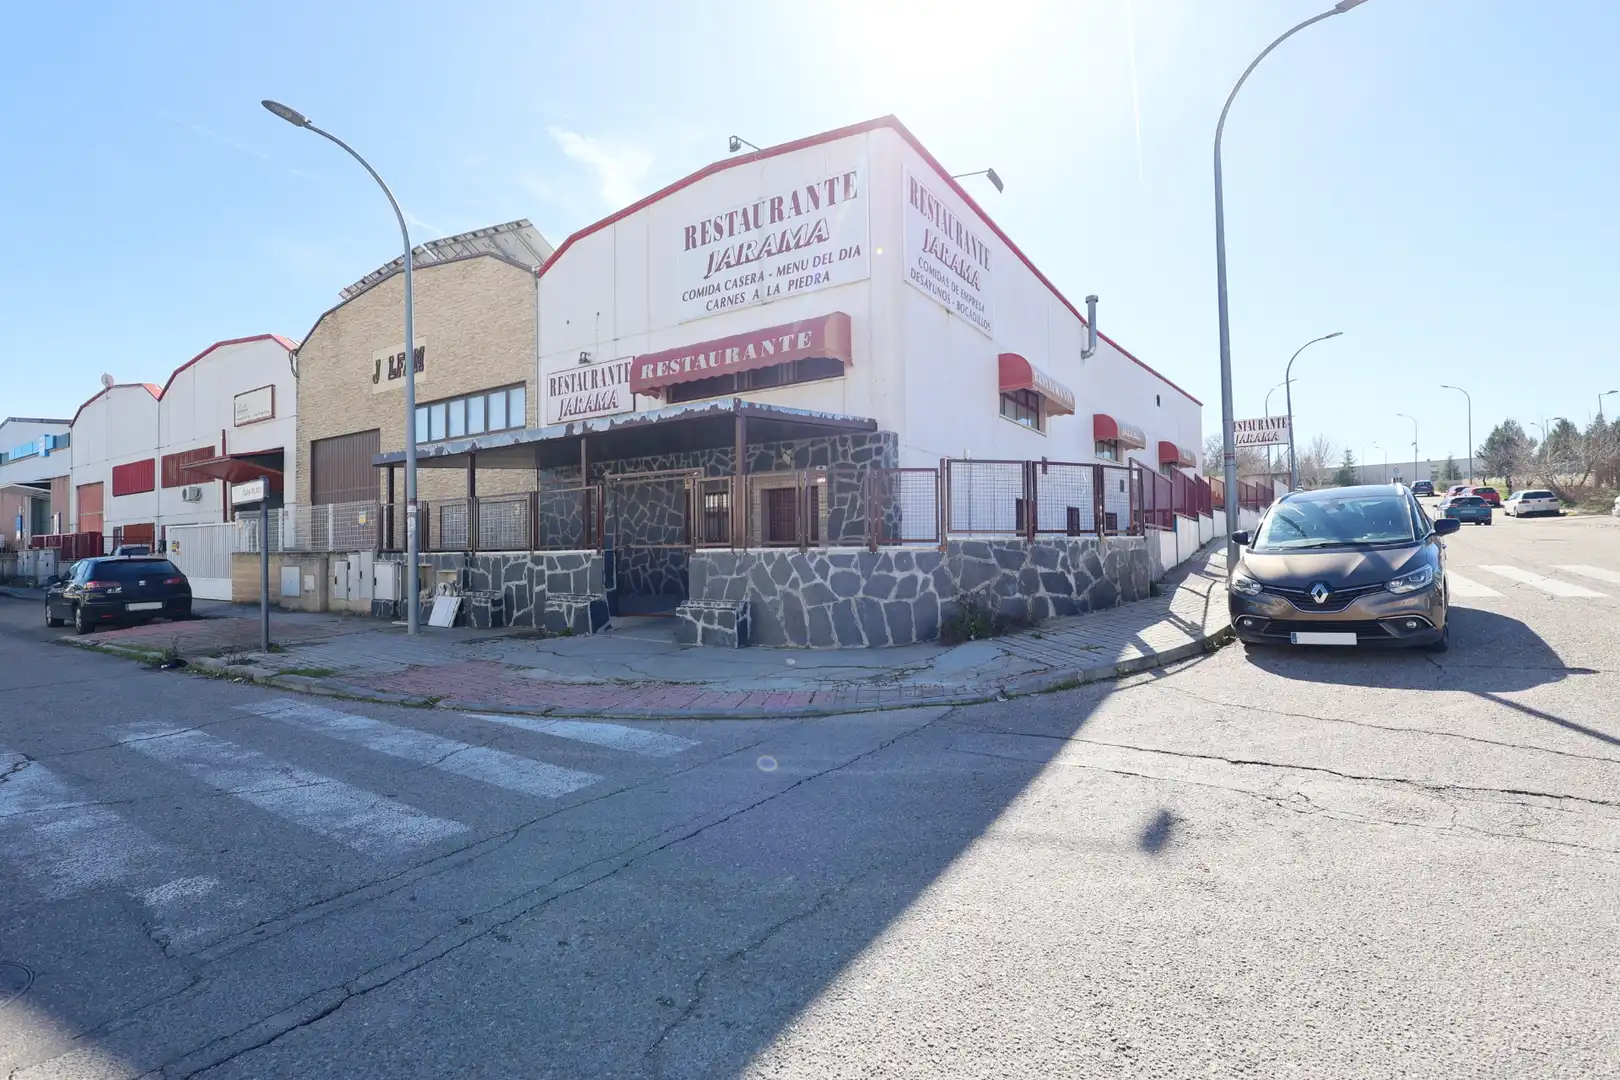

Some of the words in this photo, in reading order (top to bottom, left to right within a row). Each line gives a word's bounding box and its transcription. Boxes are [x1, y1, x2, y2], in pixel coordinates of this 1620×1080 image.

[684, 170, 858, 251] RESTAURANTE
[909, 176, 990, 272] RESTAURANTE
[682, 283, 721, 302] COMIDA
[724, 271, 764, 291] CASERA
[776, 258, 809, 277] MENU
[812, 252, 833, 268] DEL
[839, 245, 861, 261] DIA
[703, 218, 830, 279] JARAMA
[922, 228, 981, 291] JARAMA
[706, 292, 746, 311] CARNES
[752, 289, 759, 300] A
[767, 284, 781, 296] LA
[788, 271, 830, 292] PIEDRA
[910, 268, 950, 304] DESAYUNOS
[957, 301, 991, 331] BOCADILLOS
[918, 257, 949, 287] COMIDAS
[952, 281, 959, 295] DE
[961, 289, 985, 314] EMPRESA
[372, 359, 381, 384] J
[550, 362, 631, 397] RESTAURANTE
[640, 331, 813, 380] RESTAURANTE
[558, 388, 619, 421] JARAMA
[1234, 417, 1287, 432] ESTAURANTE
[1236, 431, 1279, 444] JARAMA
